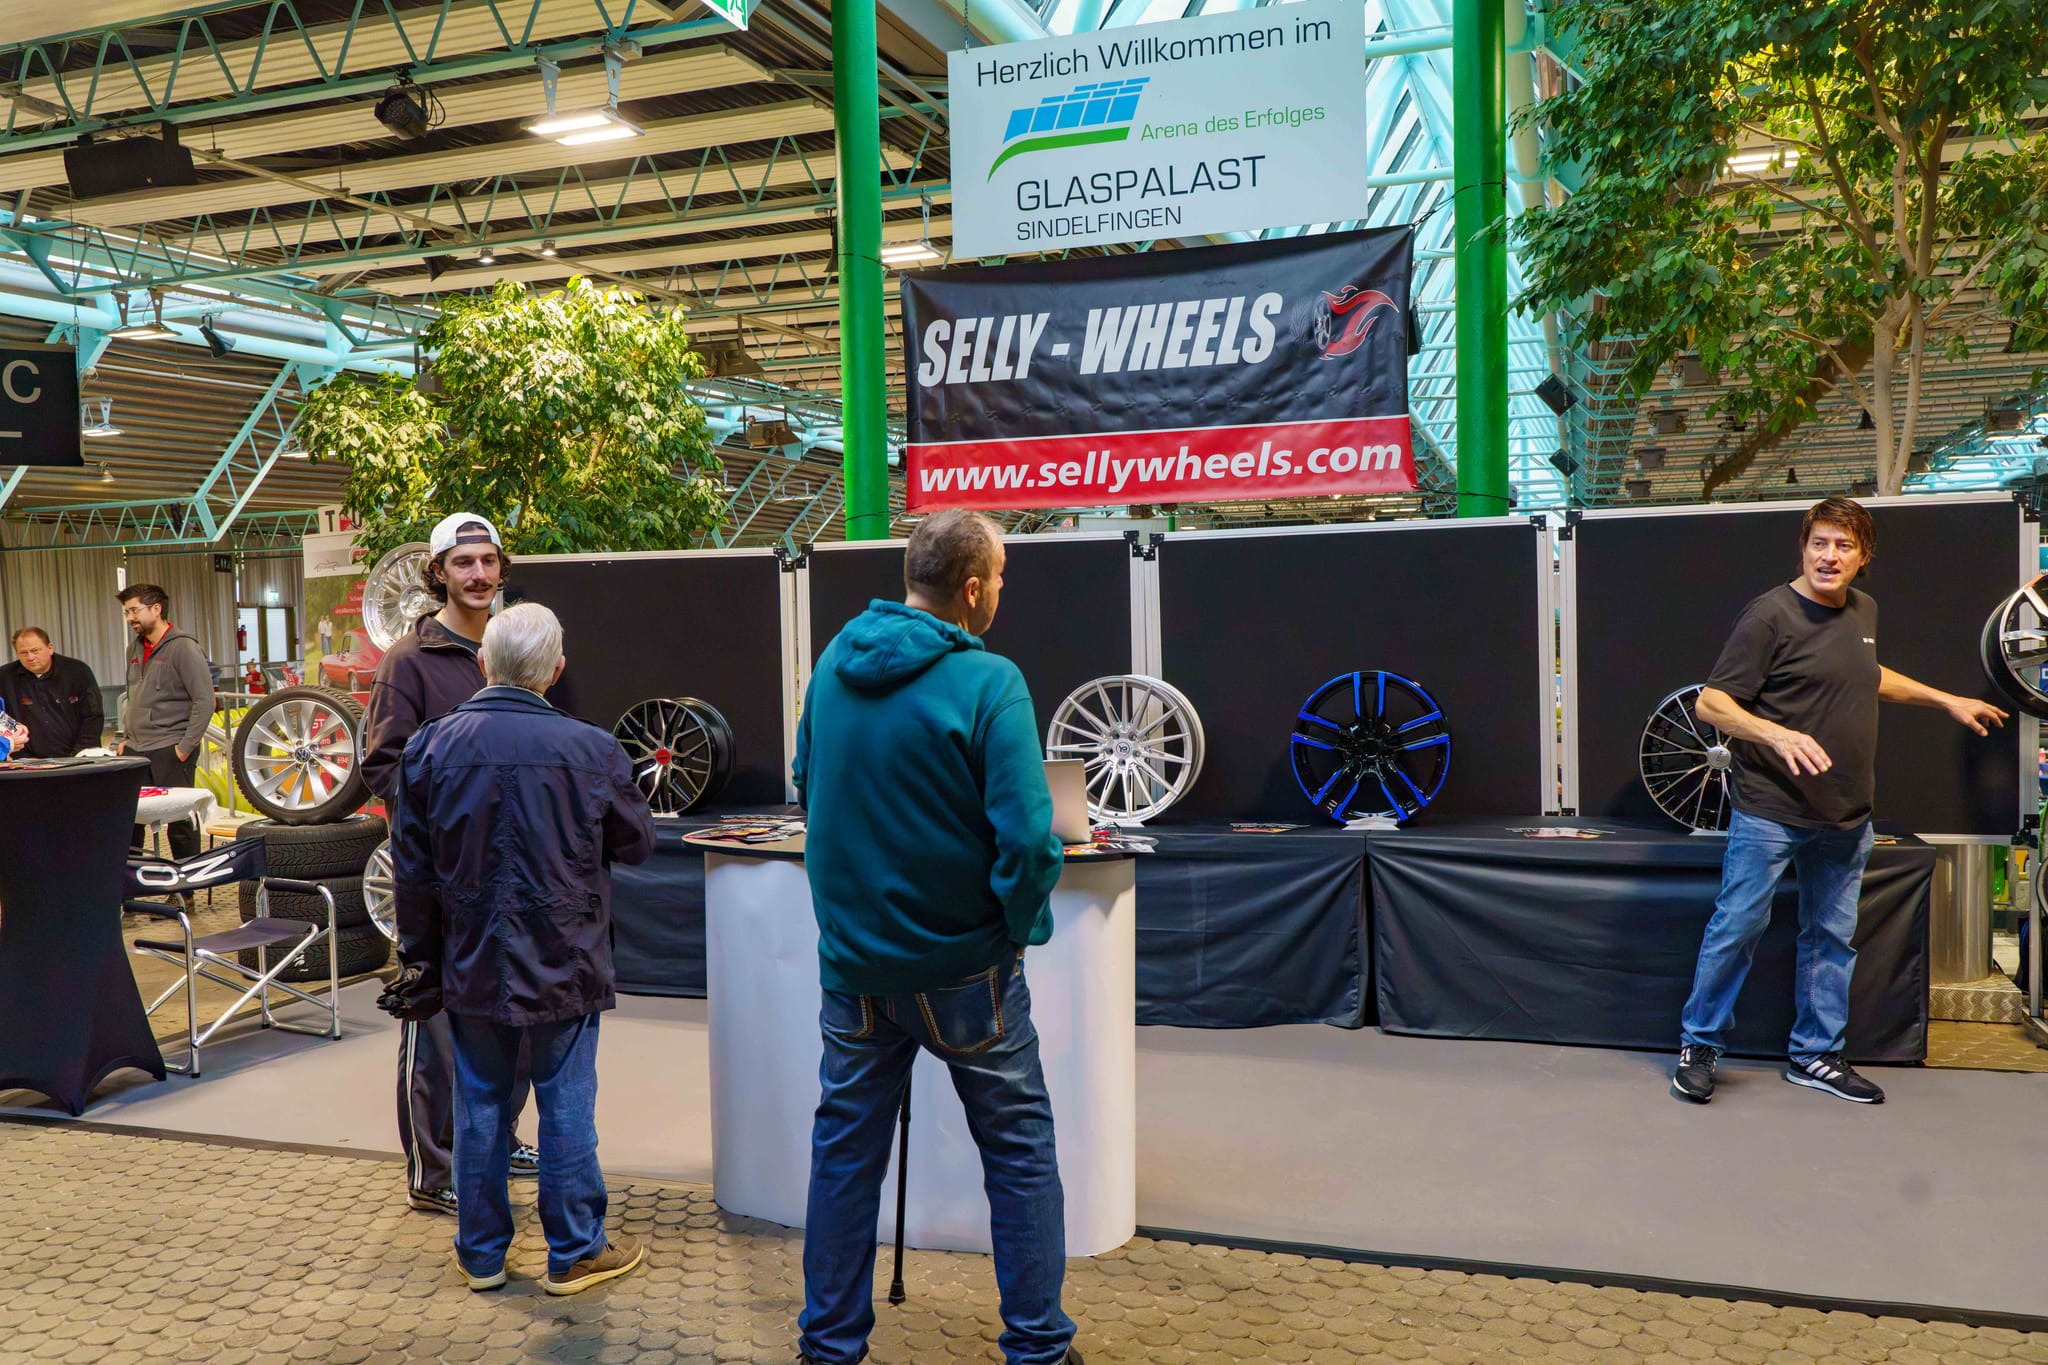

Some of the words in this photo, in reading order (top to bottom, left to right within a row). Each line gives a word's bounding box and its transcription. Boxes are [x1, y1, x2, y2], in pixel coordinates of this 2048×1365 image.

[977, 48, 1088, 87] Herzlich
[1098, 26, 1284, 70] Willkommen
[1295, 16, 1331, 44] im
[1140, 122, 1198, 142] Arena
[1204, 115, 1239, 133] des
[1245, 105, 1326, 129] Erfolges
[1016, 154, 1266, 211] GLASPALAST
[1016, 205, 1182, 241] SINDELFINGEN
[917, 312, 1050, 387] SELLY
[1079, 292, 1284, 375] WHEELS
[2, 359, 42, 404] C
[919, 441, 1402, 493] www.sellywheels.com
